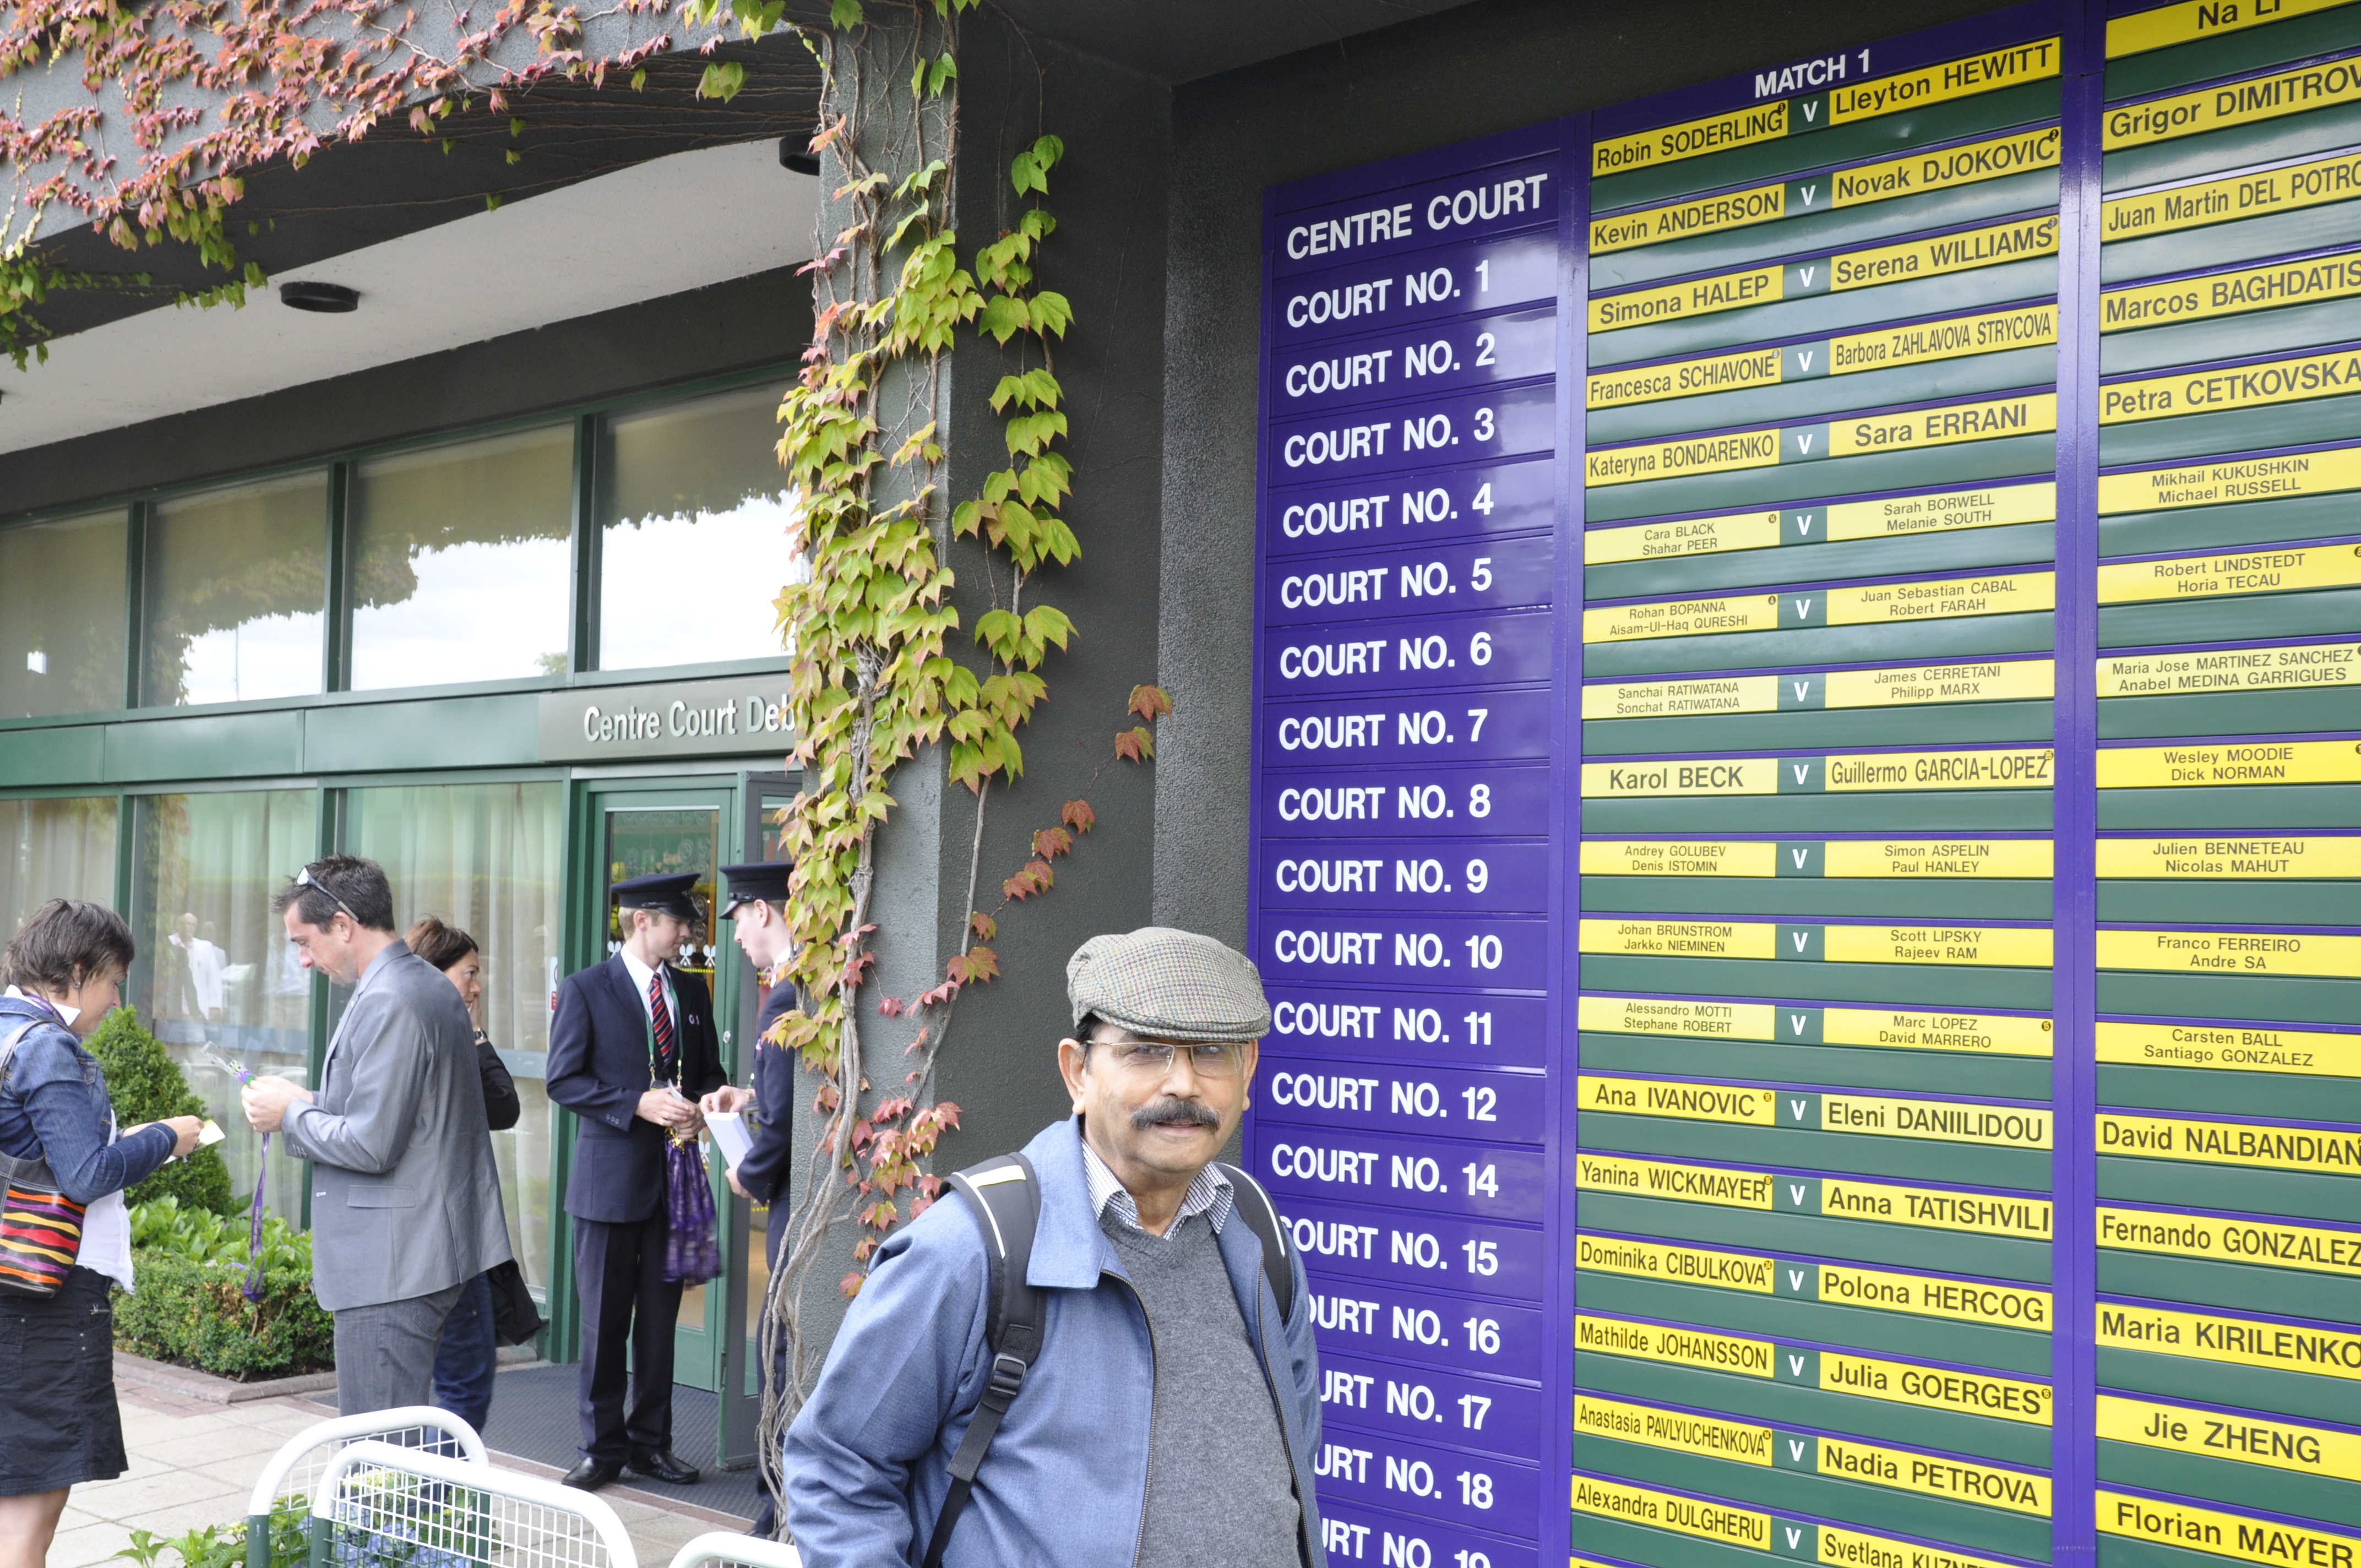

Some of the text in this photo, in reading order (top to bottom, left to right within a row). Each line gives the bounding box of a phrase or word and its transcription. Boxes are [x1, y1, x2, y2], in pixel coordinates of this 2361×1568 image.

[1755, 48, 1869, 99] MATCH 1
[1836, 42, 2053, 115] Lleyton HEWITT
[1838, 136, 2054, 199] Novak DJOKOVIC
[1287, 173, 1548, 260] CENTRE COURT
[1600, 274, 1769, 324] Simona HALEP
[2106, 259, 2361, 323] Marcos BAGHDATIS
[1836, 312, 2051, 366] Barbora ZAHLAVOVA STRYCOVA
[1286, 332, 1495, 398] COURT NO. 2
[2106, 357, 2361, 416] Petra CETKOVSKA
[1590, 434, 1773, 477] Kateryna BONDARENKO
[2152, 458, 2308, 487] Mikhail KUKUSHKIN
[2158, 477, 2301, 503] Michael RUSSELL
[1282, 482, 1494, 538] COURT NO. 4
[1884, 493, 1994, 516] Sarah BORWELL
[1645, 522, 1715, 541] Cara BLACK
[1887, 509, 1991, 531] Melanie SOUTH
[1642, 537, 1717, 556] Shahar PEER
[2155, 553, 2305, 578] Robert LINDSTEDT
[1861, 579, 2016, 602] Juan Sebastian CABAL
[2178, 572, 2280, 592] Horia TECAU
[1629, 601, 1726, 619] Rohan BOPANNA
[1890, 597, 1985, 616] Robert FARAH
[1610, 614, 1747, 635] Aisam-Ul-Haq QURESHI
[1280, 631, 1492, 679] COURT NO. 6
[2113, 649, 2353, 675] Maria Jose MARTINEZ SANCHEZ
[1874, 665, 2000, 684] James CERRETANI
[2119, 667, 2346, 691] Anabel MEDINA GARRIGUES
[1618, 682, 1739, 699] Sanchai RATIWATANA
[1891, 682, 1979, 699] Philipp MARX
[1617, 697, 1739, 714] Sonchat RATIWATANA
[584, 705, 660, 742] Centre
[668, 699, 736, 737] Court
[2163, 747, 2293, 765] Wesley MOODIE
[1610, 765, 1743, 790] Karol BECK
[1831, 755, 2049, 784] Guillermo GARCIA-LOPEZ
[2172, 765, 2284, 781] Dick NORMAN
[1279, 783, 1491, 821] COURT NO. 8
[1625, 845, 1726, 858] Andrey GOLUBEV
[1885, 844, 1989, 857] Simon ASPELIN
[2153, 841, 2304, 854] Julien BENNETEAU
[1632, 859, 1717, 872] Denis ISTOMIN
[1892, 861, 1979, 872] Paul HANLEY
[2166, 859, 2289, 873] Nicolas MAHUT
[1618, 923, 1732, 937] Johan BRUNSTROM
[1890, 929, 1981, 943] Scott LIPSKY
[1275, 929, 1503, 970] COURT NO. 10
[1624, 938, 1724, 952] Jarkko NIEMINEN
[1895, 945, 1977, 960] Rajeev RAM
[2158, 935, 2300, 952] Franco FERREIRO
[2190, 954, 2266, 969] Andre SA
[1625, 1002, 1731, 1017] Alessandro MOTTI
[1624, 1016, 1732, 1033] Stephane ROBERT
[1894, 1015, 1977, 1031] Marc LOPEZ
[1879, 1030, 1991, 1048] David MARRERO
[2172, 1028, 2282, 1047] Carsten BALL
[2144, 1044, 2313, 1066] Santiago GONZALEZ
[1271, 1072, 1497, 1122] COURT NO. 12
[1595, 1083, 1754, 1117] Ana IVANOVIC
[1829, 1101, 2042, 1142] Eleni DANIILIDOU
[2103, 1215, 2361, 1267] Fernando GONZALEZ
[1391, 1230, 1448, 1270] NO.
[1462, 1239, 1498, 1276] 15
[1581, 1240, 1766, 1286] Dominika CIBULKOVA
[2102, 1310, 2361, 1369] Maria KIRILENKO
[1579, 1403, 1765, 1457] Anastasia PAVLYUCHENKOVA
[2144, 1412, 2320, 1464] Jie ZHENG
[1826, 1444, 2038, 1507] Nadia PETROVA
